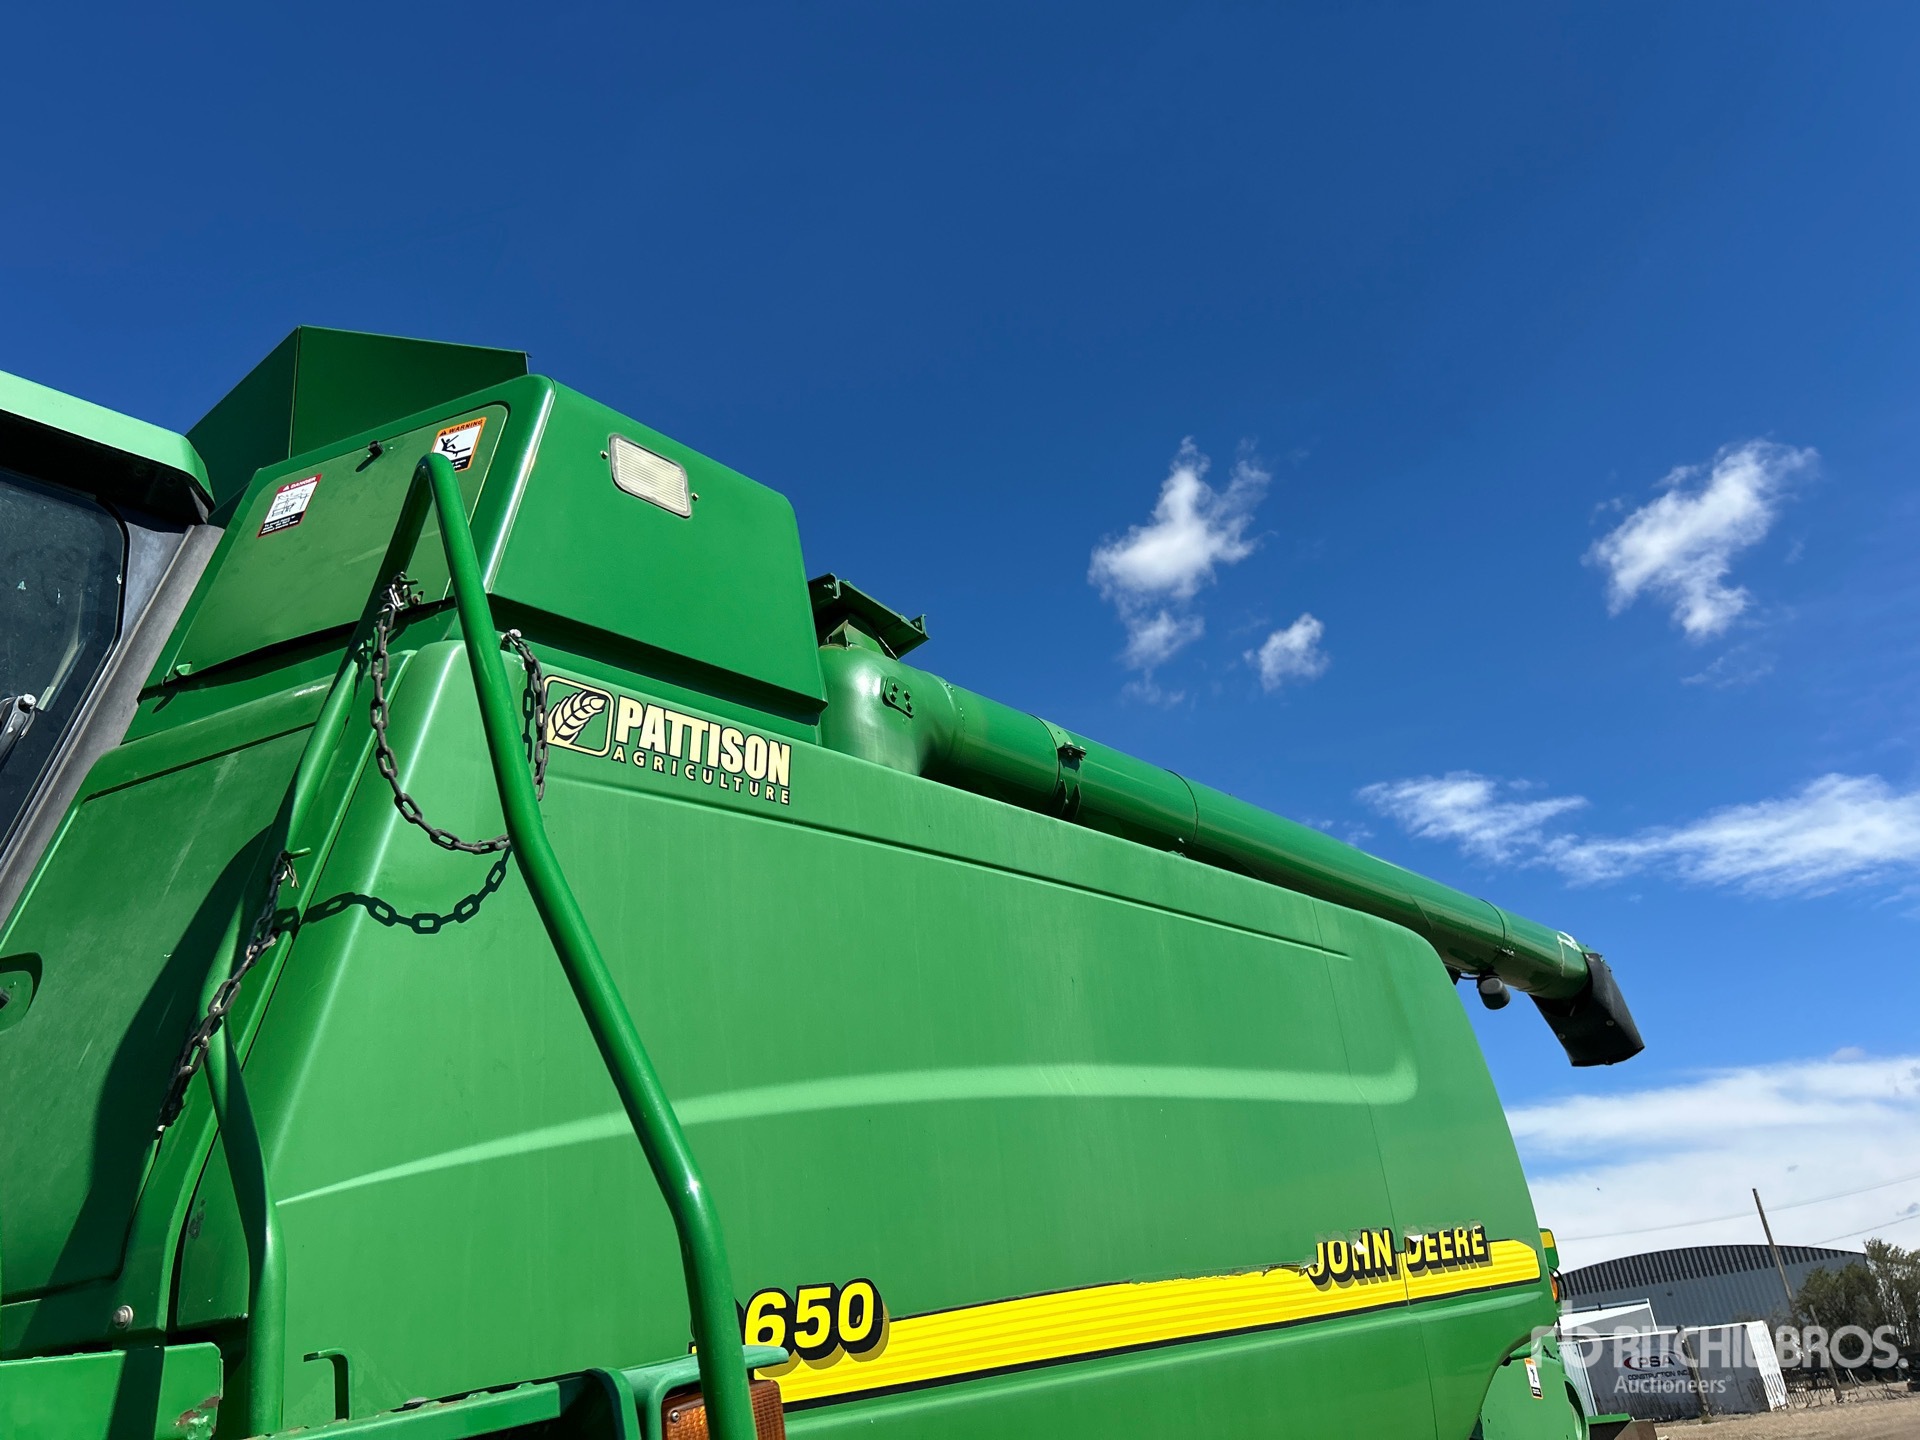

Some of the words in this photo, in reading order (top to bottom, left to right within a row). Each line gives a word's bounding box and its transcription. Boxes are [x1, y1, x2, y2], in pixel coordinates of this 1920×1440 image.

[449, 419, 483, 434] WARNING
[614, 696, 791, 787] PATTISON
[611, 746, 790, 805] AGRICULTURE
[1307, 1229, 1398, 1284] JOHN
[1637, 1354, 1675, 1369] PSA
